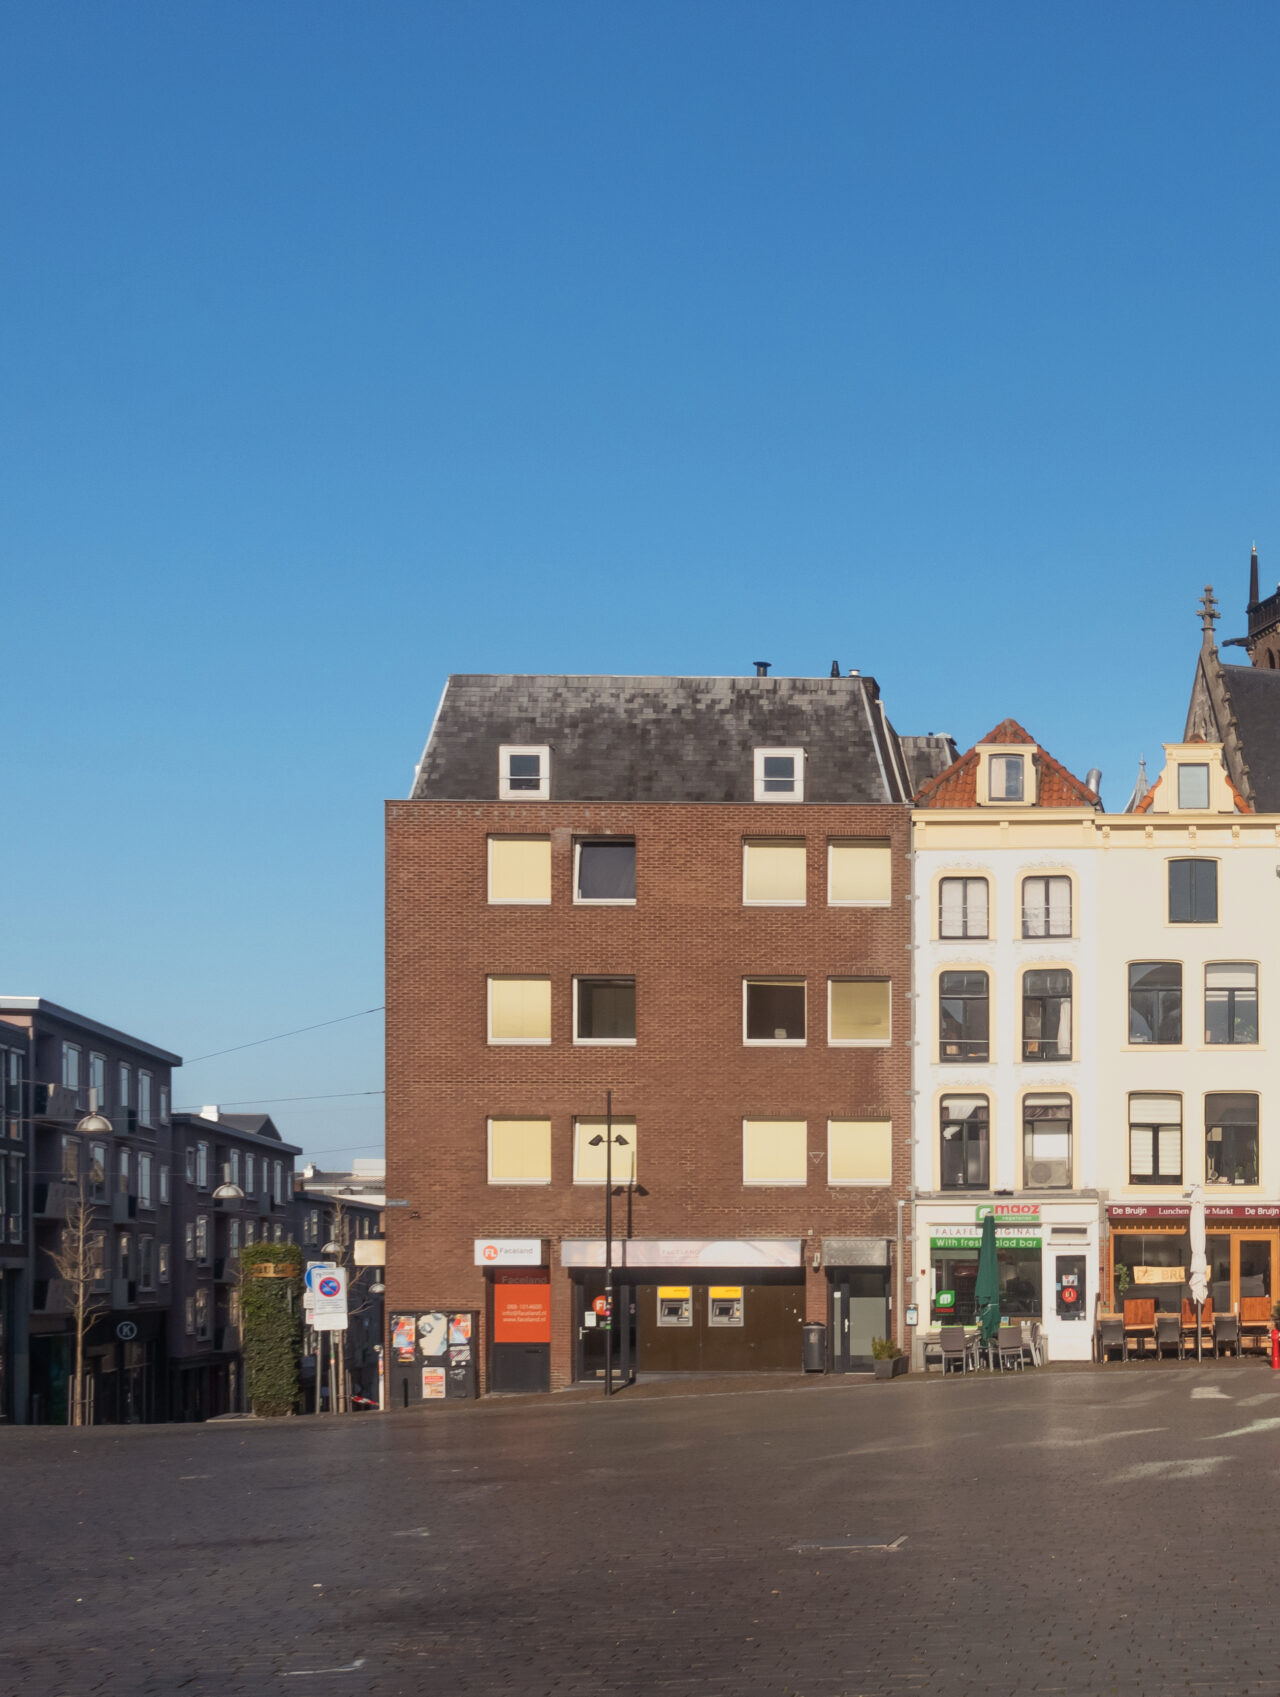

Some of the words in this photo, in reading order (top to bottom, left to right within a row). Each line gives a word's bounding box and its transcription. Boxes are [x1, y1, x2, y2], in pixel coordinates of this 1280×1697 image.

[994, 1204, 1039, 1214] maoz
[1113, 1207, 1124, 1215] De
[1125, 1206, 1148, 1216] Bruijn
[1158, 1207, 1190, 1215] Lunchen
[1211, 1207, 1234, 1215] Markt
[1245, 1207, 1256, 1215] De
[1257, 1206, 1280, 1216] Bruijn
[935, 1228, 978, 1236] FALAFEL
[995, 1228, 1037, 1236] RIGINAL
[936, 1238, 958, 1248] With
[995, 1238, 1017, 1248] alad
[1019, 1238, 1037, 1248] bar
[485, 1248, 497, 1258] FL
[499, 1247, 534, 1255] Faceland
[501, 1275, 547, 1285] Faceland
